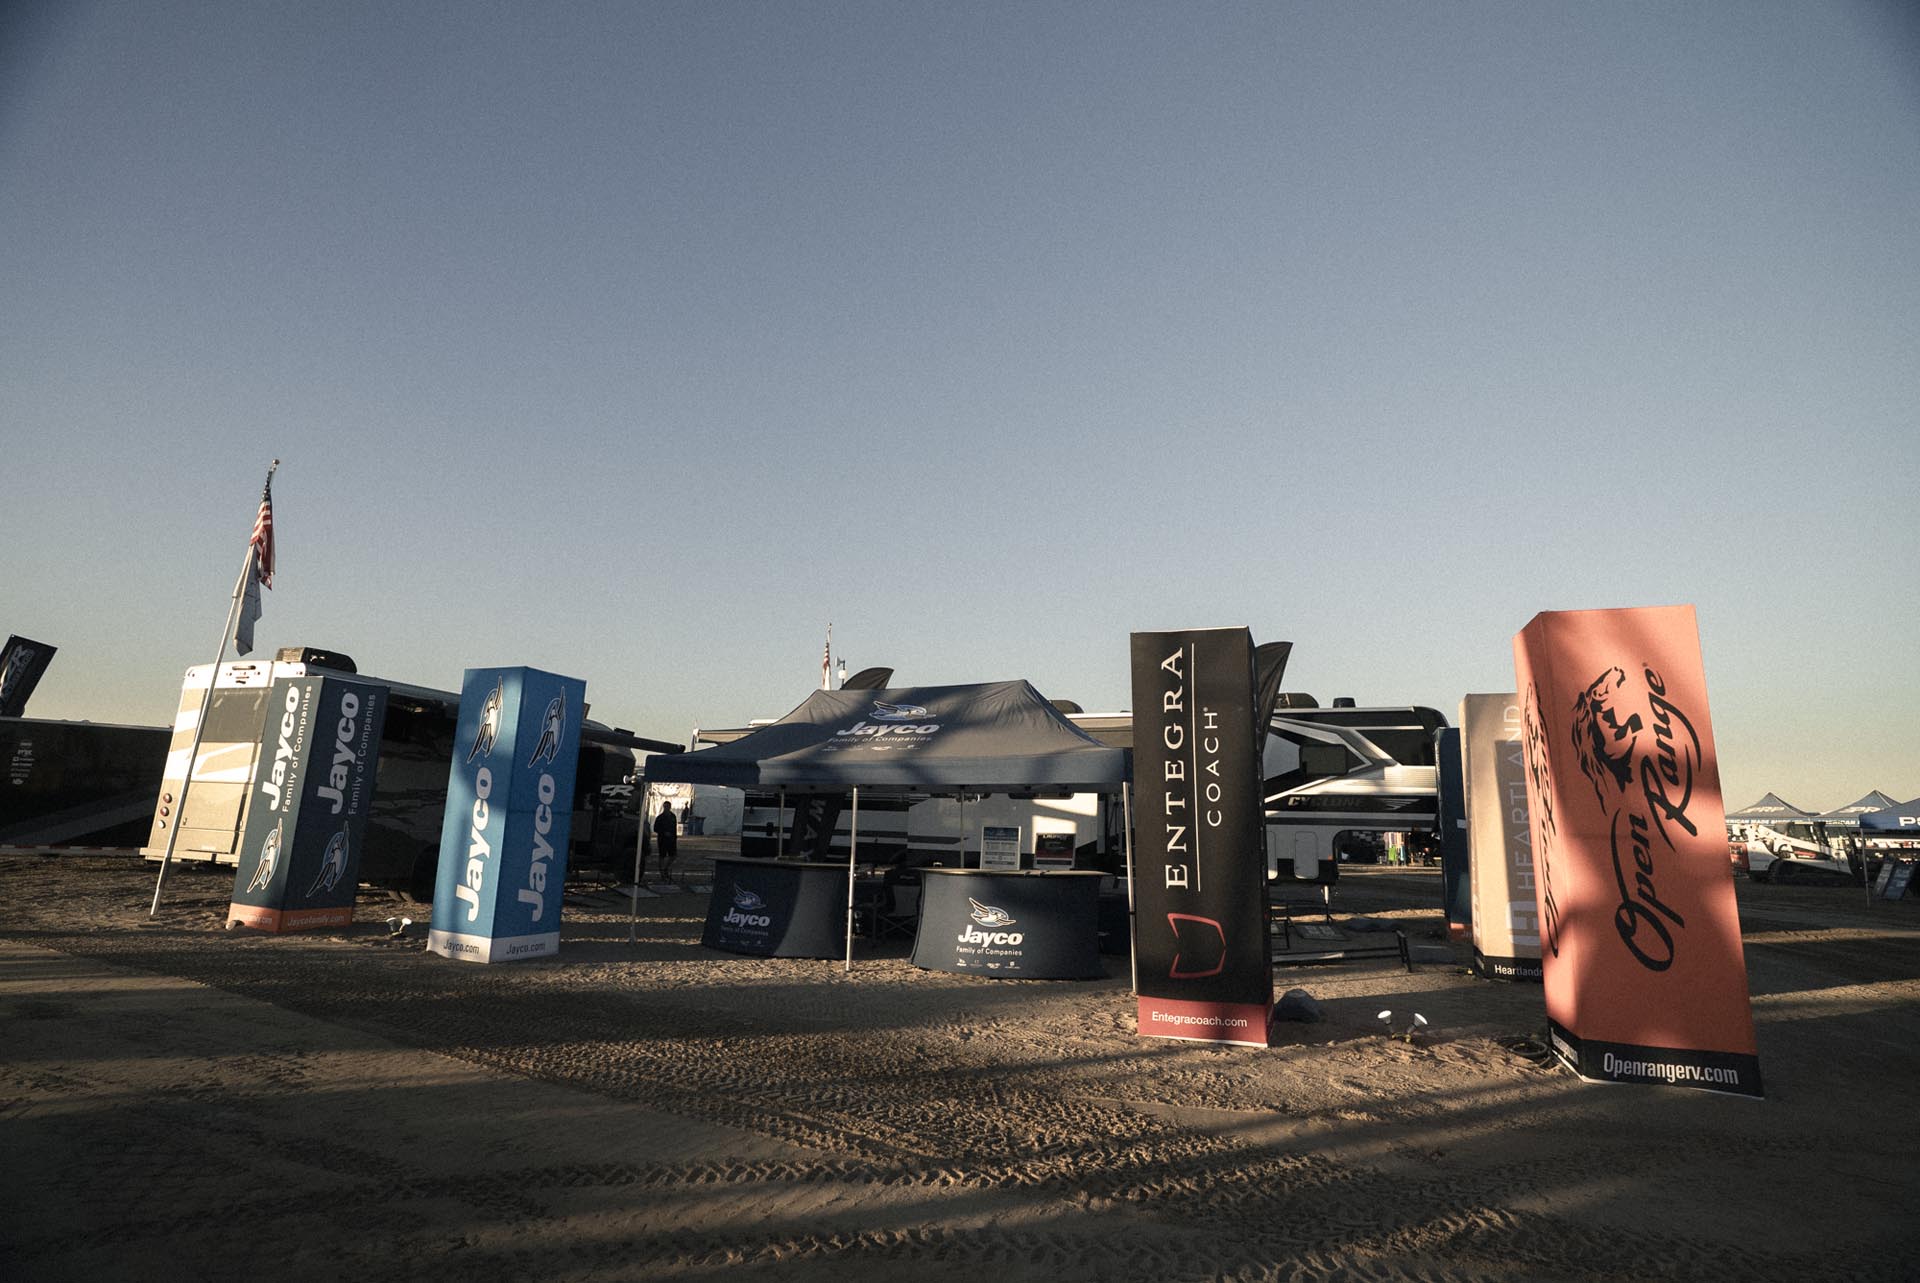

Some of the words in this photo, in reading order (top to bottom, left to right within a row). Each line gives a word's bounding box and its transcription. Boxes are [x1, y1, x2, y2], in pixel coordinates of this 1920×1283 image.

[294, 685, 312, 753] Companies
[358, 694, 376, 757] Companies
[836, 721, 940, 738] Jayco
[261, 686, 300, 811] Jayco
[292, 757, 299, 769] of
[316, 692, 360, 815] Jayco
[356, 760, 365, 772] of
[1640, 667, 1701, 853] Range
[1160, 647, 1189, 890] ENTEGRA
[1204, 712, 1222, 827] COACH
[281, 772, 297, 812] Family
[347, 777, 363, 815] Family
[455, 767, 493, 922] Jayco
[517, 773, 555, 922] Jayco
[1611, 808, 1685, 972] Open
[723, 907, 770, 927] Jayco
[958, 925, 1023, 948] Jayco
[443, 941, 480, 954] Jayco.com
[506, 943, 546, 956] Jayco.com
[956, 946, 975, 954] Family
[985, 948, 1022, 956] Companies
[1152, 1011, 1248, 1027] Entegracoach.com
[1603, 1052, 1739, 1085] Openrangerv.com
